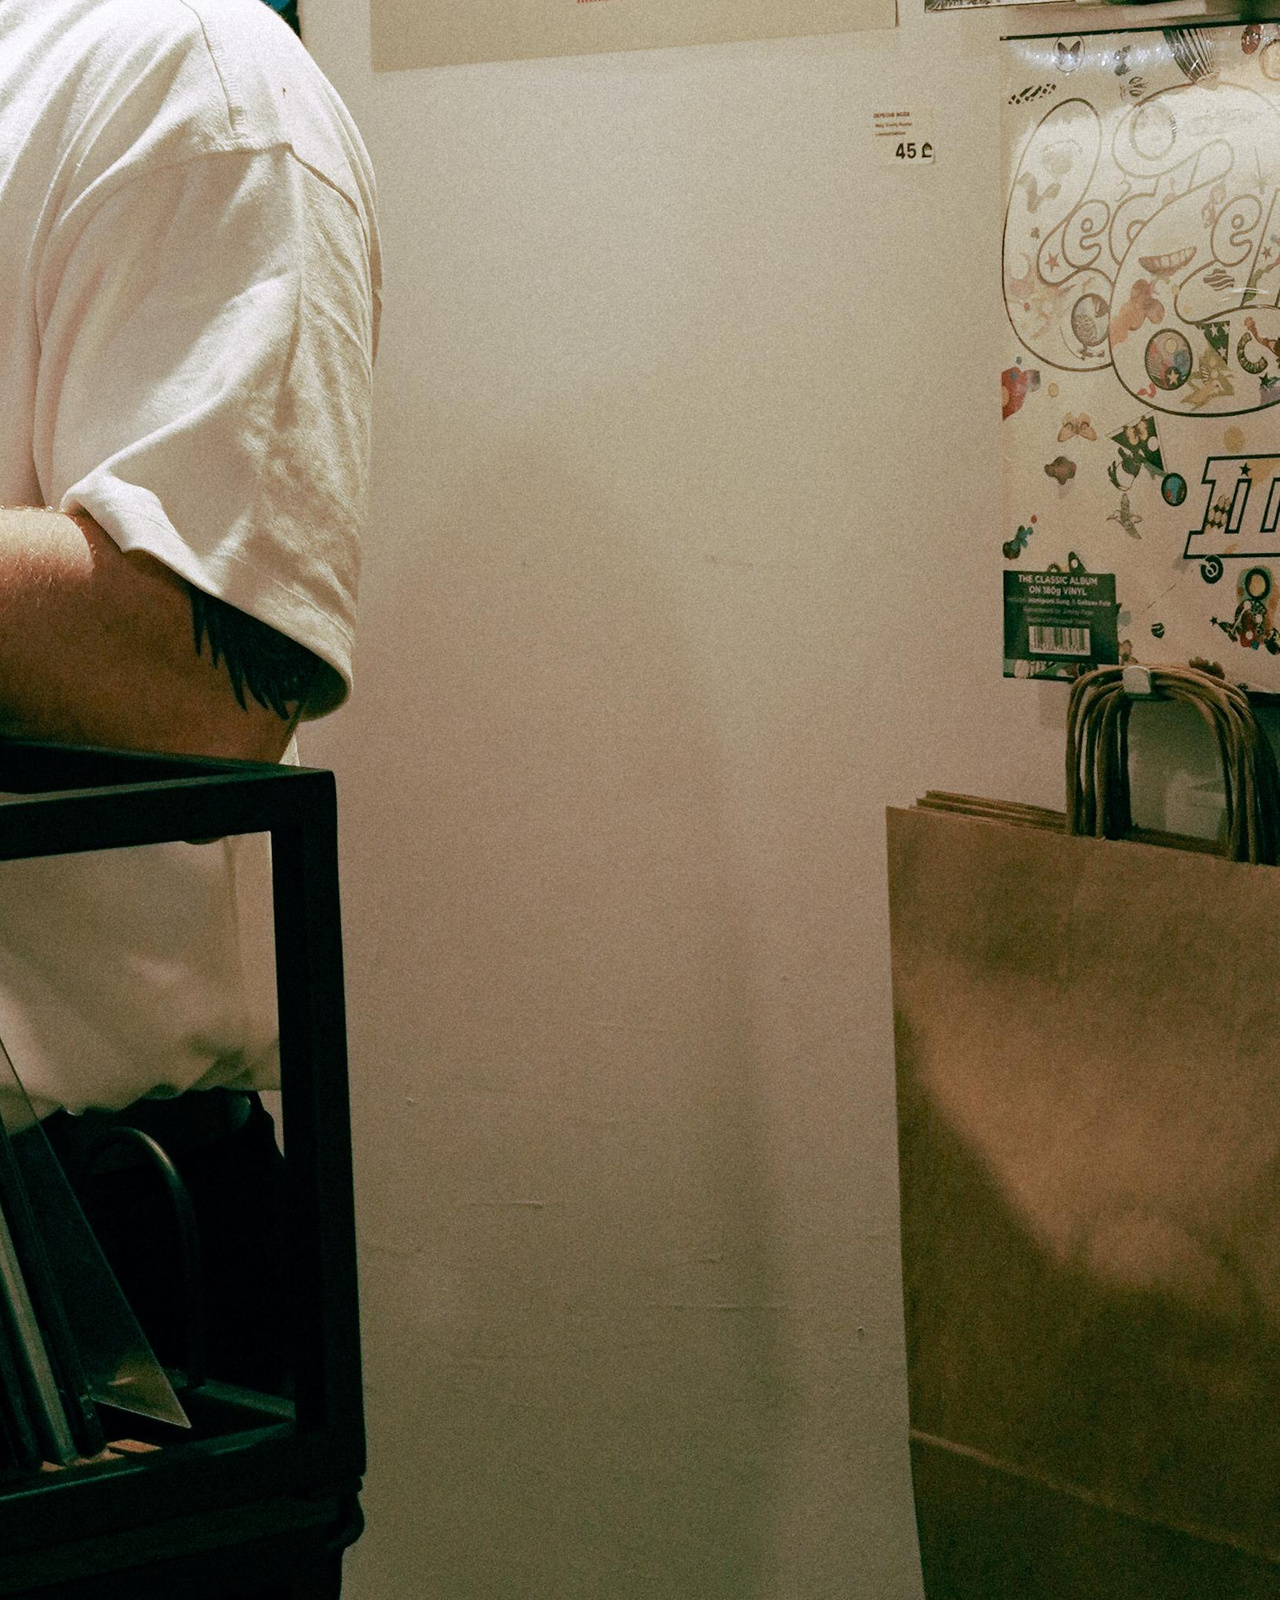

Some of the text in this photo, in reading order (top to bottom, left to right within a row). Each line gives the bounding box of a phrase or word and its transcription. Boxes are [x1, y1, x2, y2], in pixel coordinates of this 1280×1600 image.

[896, 142, 917, 159] 45
[1018, 574, 1098, 586] THE CLASSIC ALBUM
[1028, 585, 1088, 596] ON 180g VINYL
